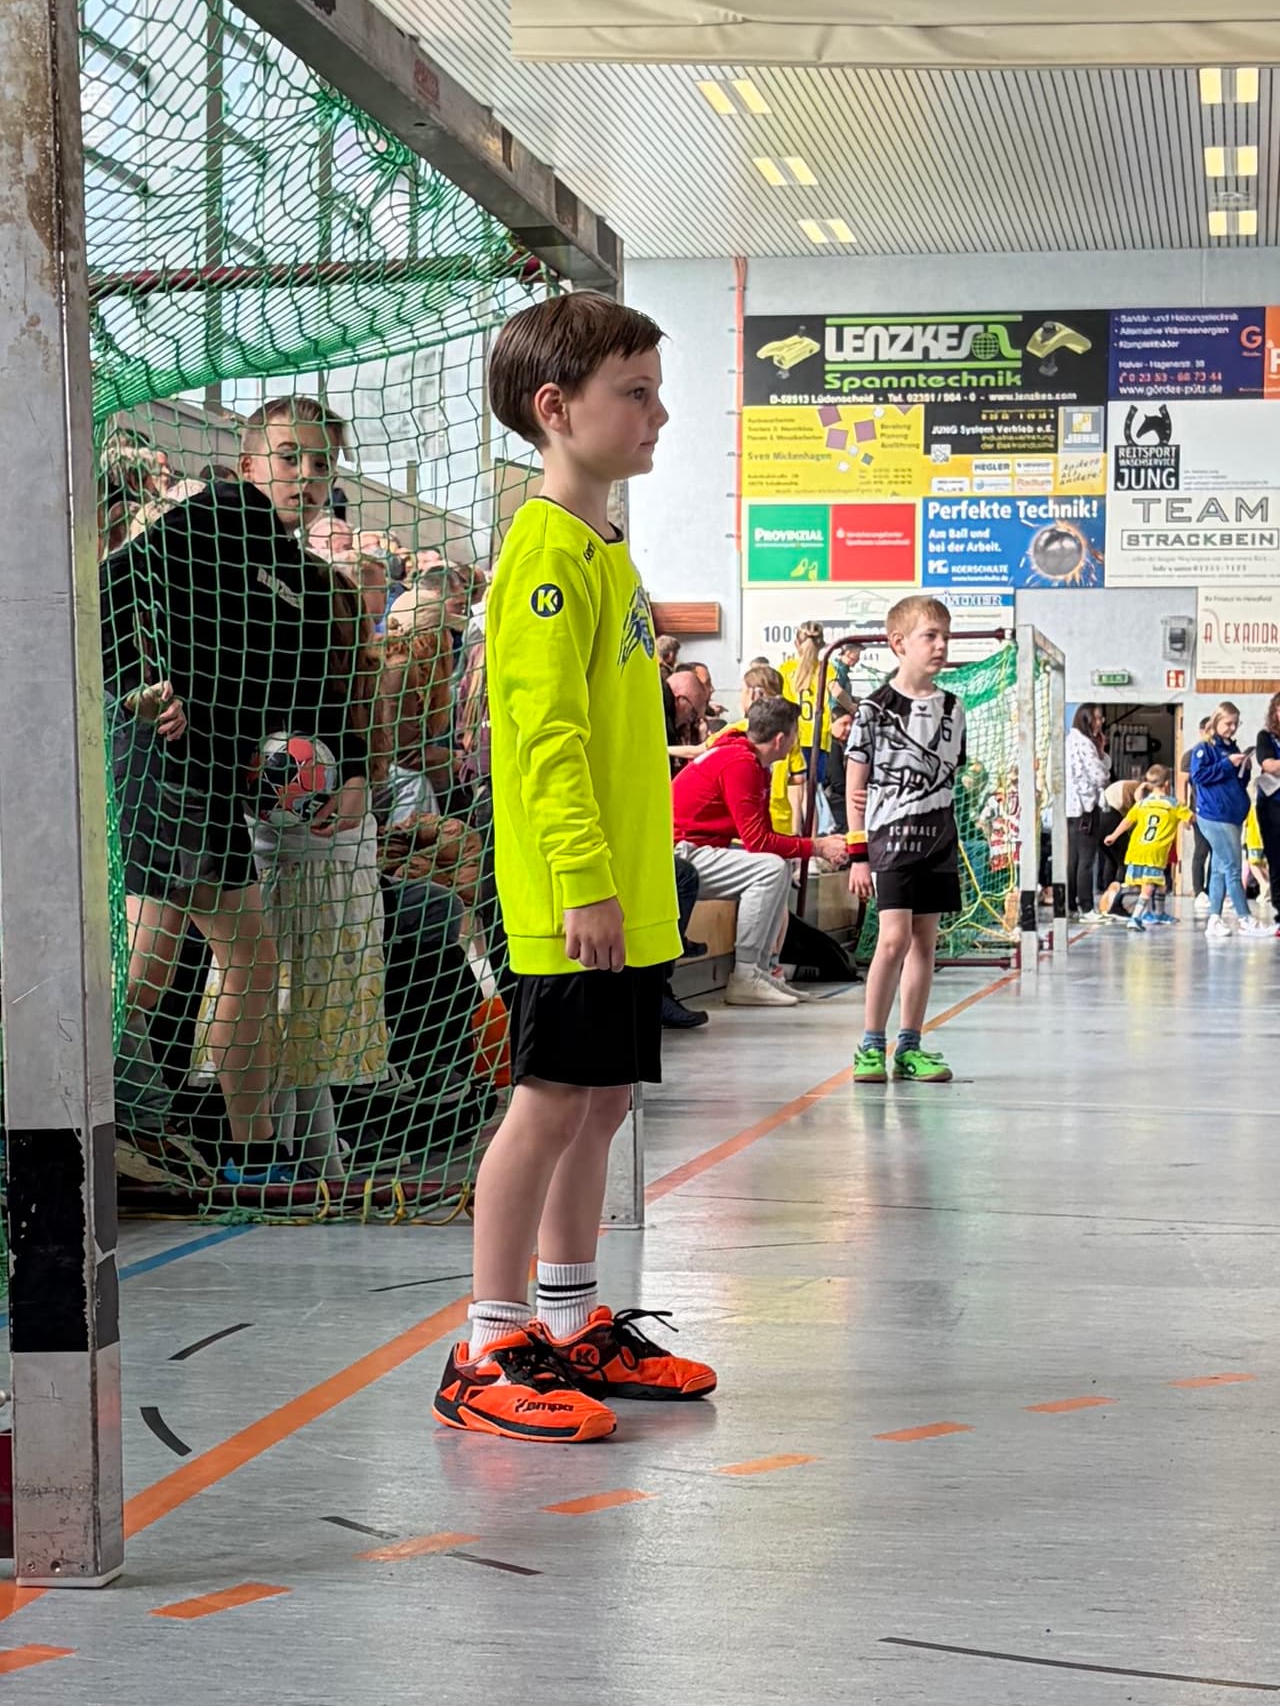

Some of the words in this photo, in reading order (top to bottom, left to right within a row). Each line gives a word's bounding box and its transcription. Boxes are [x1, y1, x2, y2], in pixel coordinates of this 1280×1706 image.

[825, 325, 986, 361] LENZKES
[1240, 326, 1262, 349] G
[825, 370, 1022, 393] Spanntechnik
[1118, 446, 1176, 458] REITSPORT
[1117, 467, 1176, 490] JUNG
[928, 500, 1012, 519] Perfekte
[1016, 498, 1098, 518] Technik!
[1132, 497, 1269, 523] TEAM
[928, 529, 947, 538] Am
[948, 528, 968, 538] Ball
[970, 528, 990, 538] und
[1126, 532, 1275, 546] STRACKBEIN
[928, 542, 945, 552] bei
[947, 541, 964, 552] der
[966, 541, 1002, 552] Arbeit.
[764, 626, 797, 643] 100
[801, 688, 814, 721] 6
[941, 716, 953, 742] 6
[1143, 813, 1161, 842] 8
